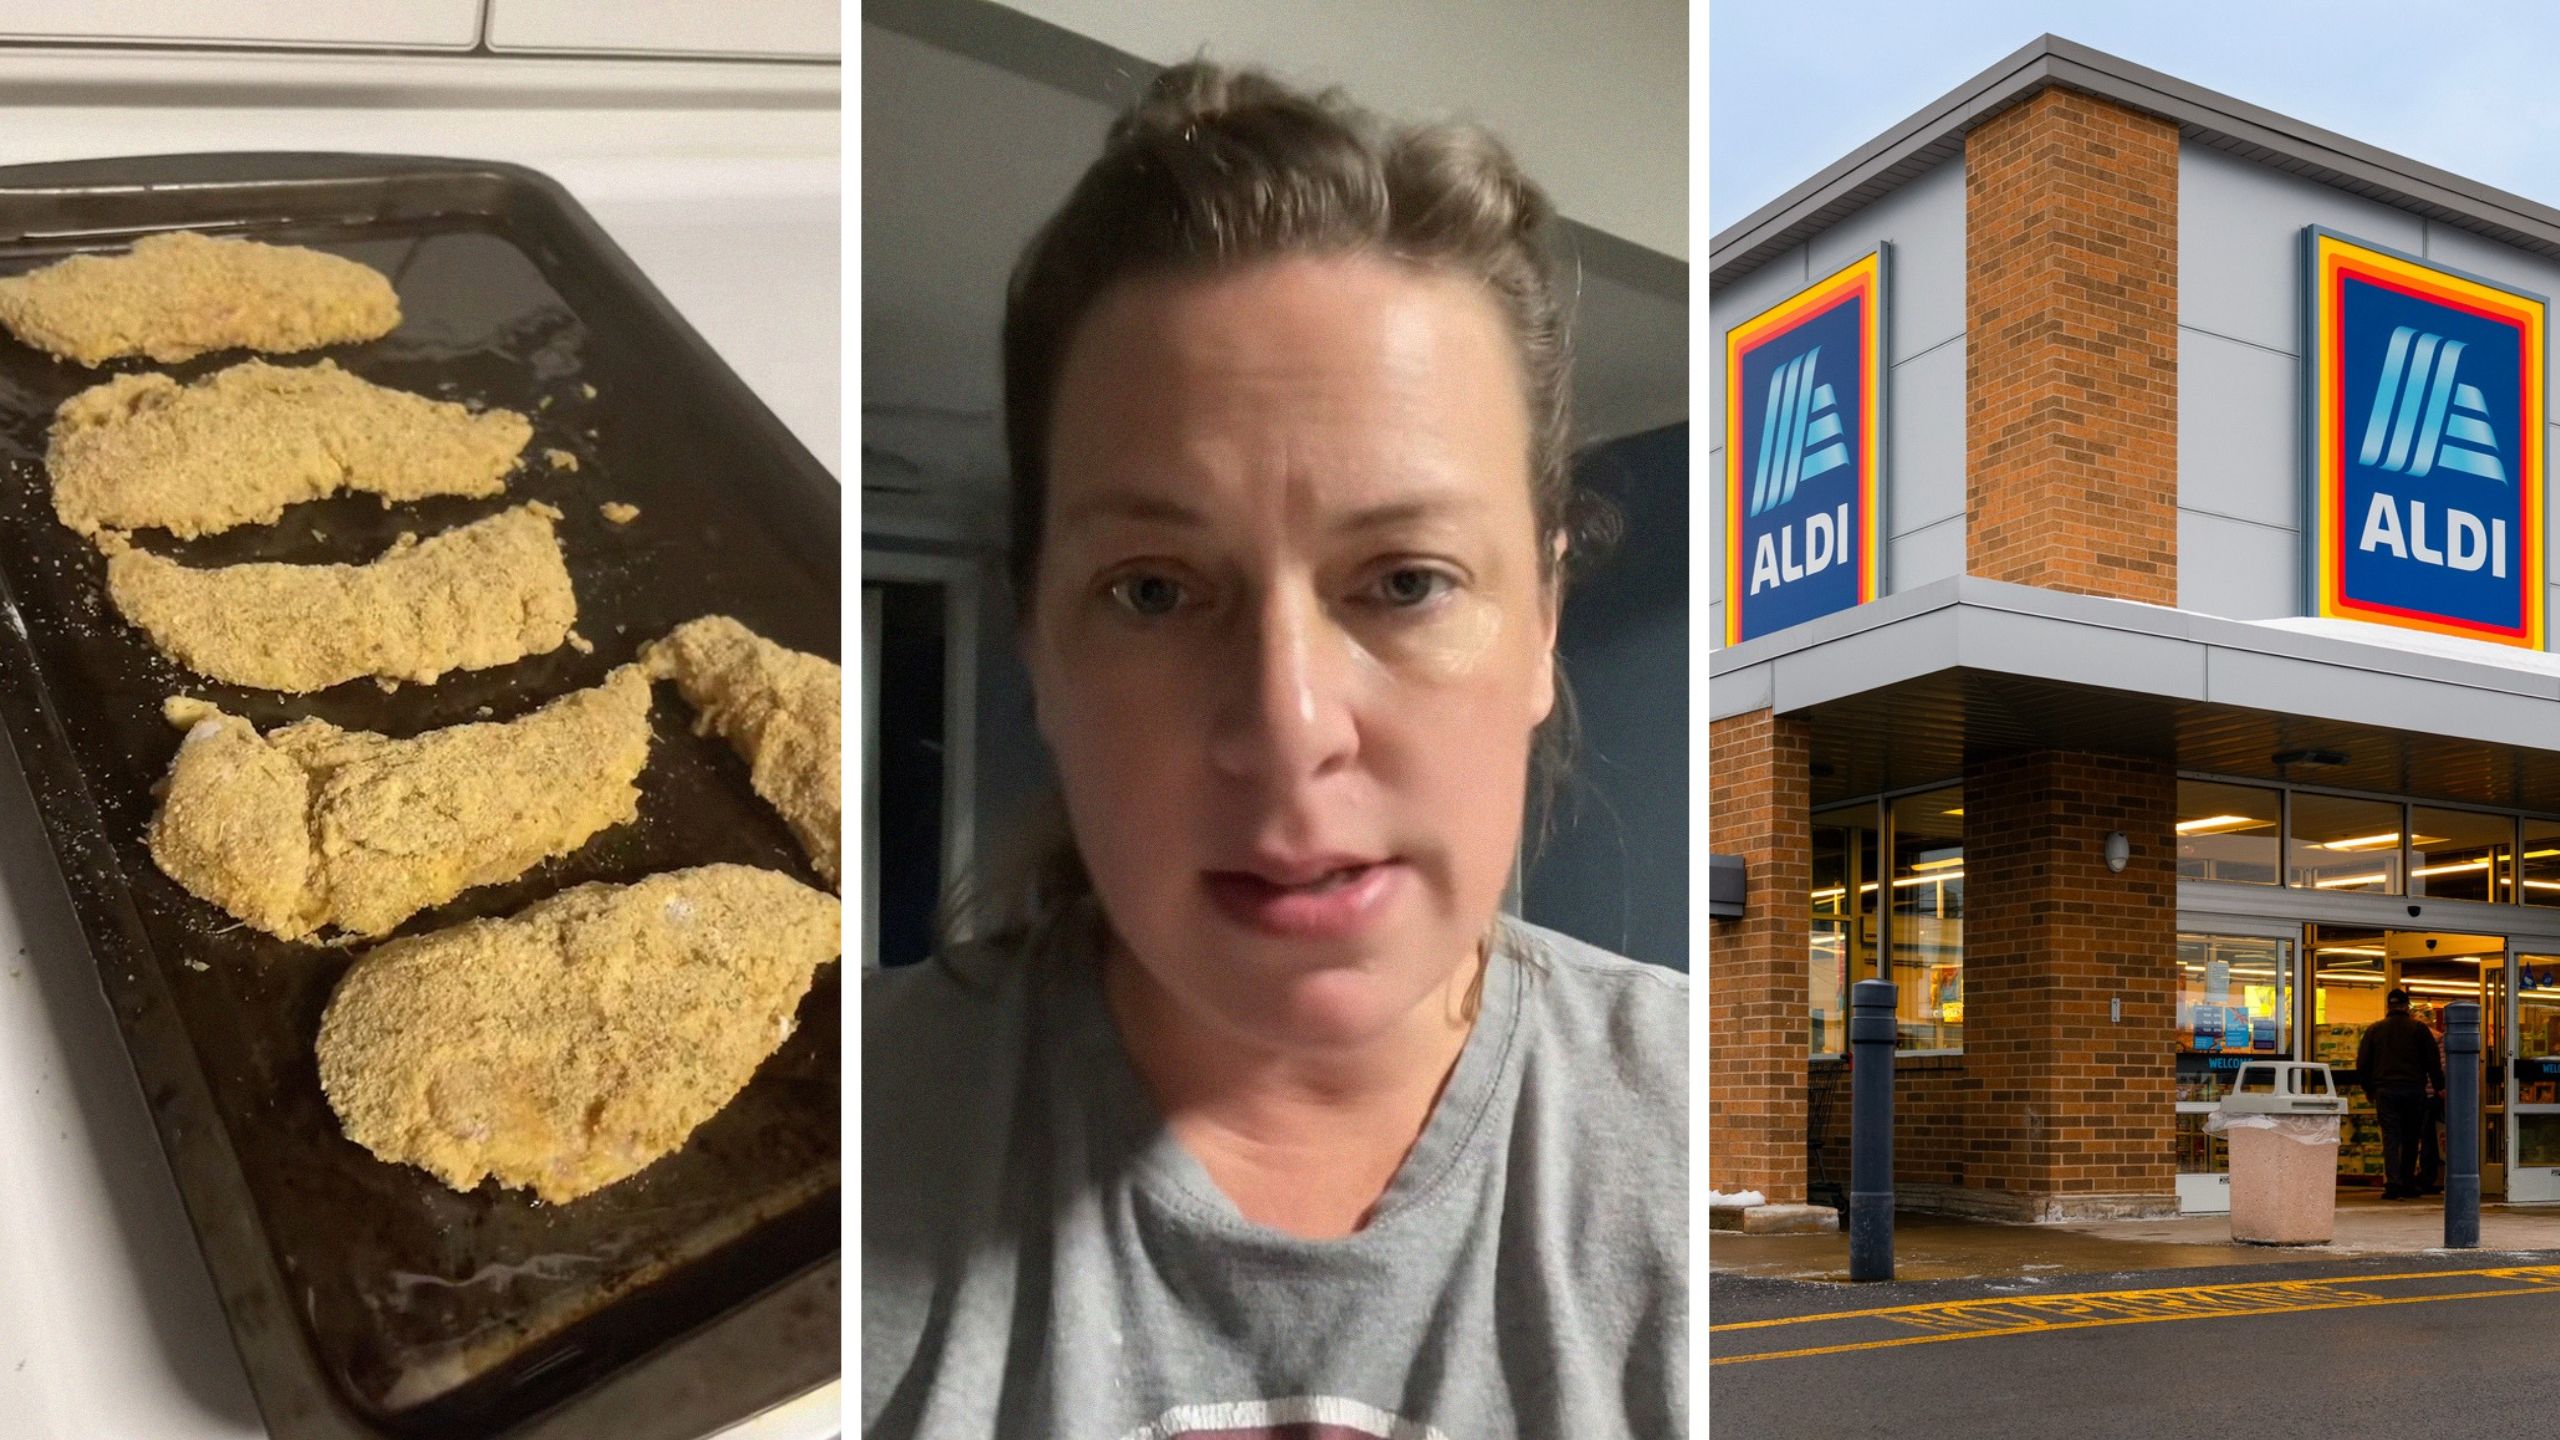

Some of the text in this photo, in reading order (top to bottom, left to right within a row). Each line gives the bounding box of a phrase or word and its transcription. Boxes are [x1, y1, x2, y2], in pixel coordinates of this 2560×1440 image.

[1750, 502, 1848, 596] ALDI
[2359, 492, 2506, 578] ALDI
[1873, 1282, 2384, 1333] NO PARKING
